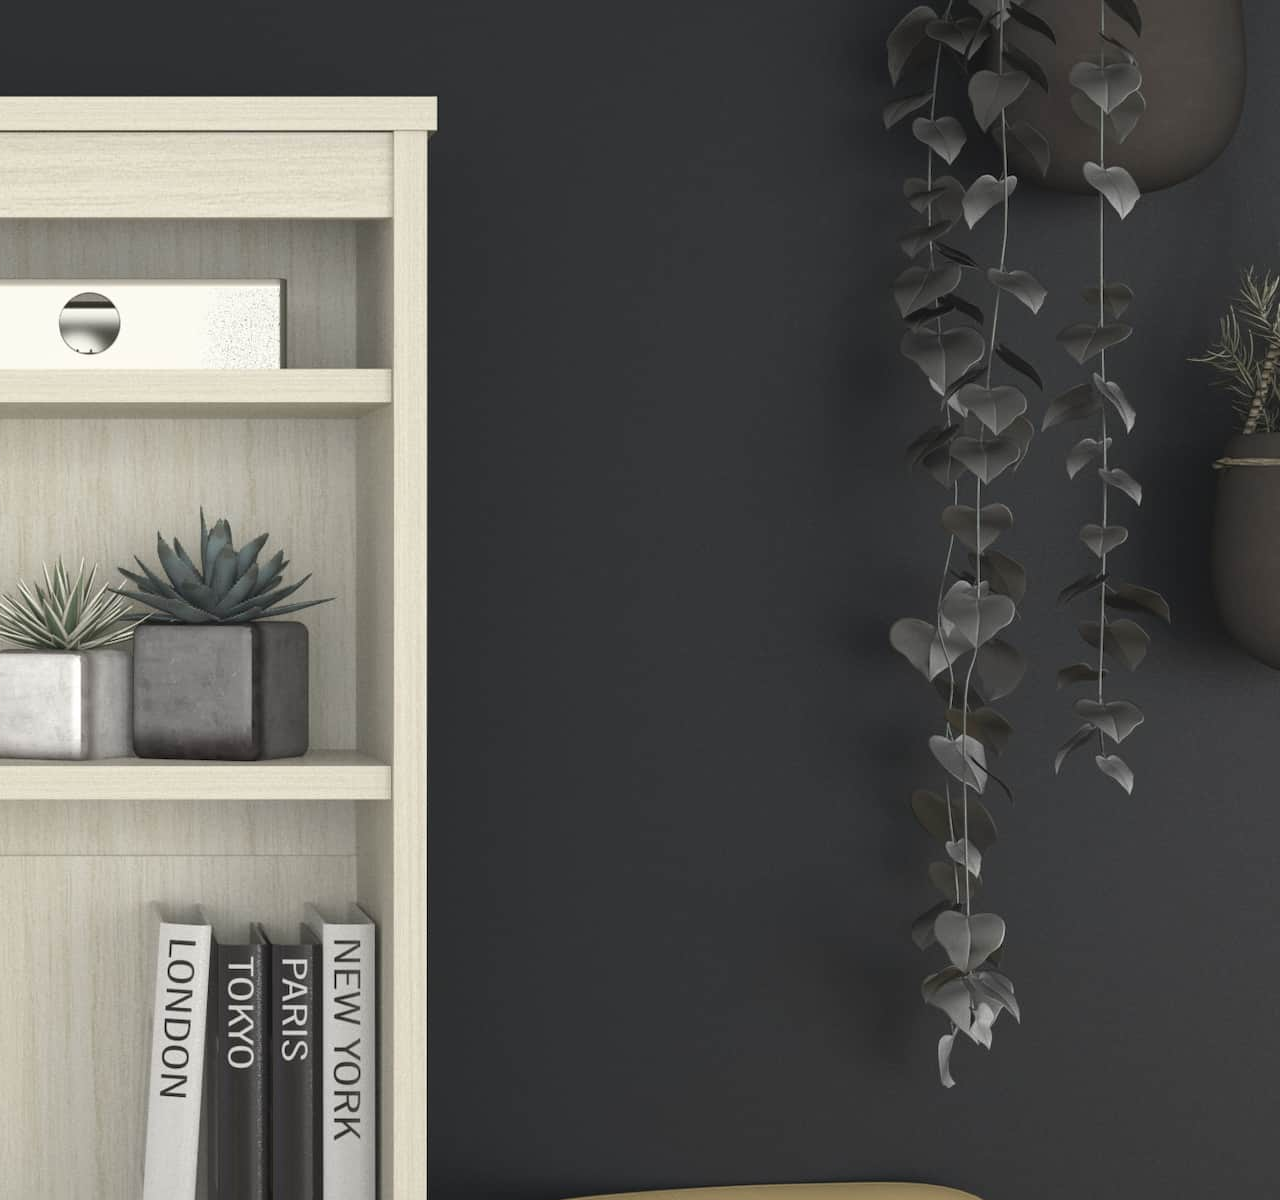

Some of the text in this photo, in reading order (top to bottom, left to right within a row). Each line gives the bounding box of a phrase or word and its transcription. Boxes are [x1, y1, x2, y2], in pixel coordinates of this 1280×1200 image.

[159, 938, 196, 1098] LONDON
[227, 956, 254, 1069] TOKYO
[281, 958, 308, 1061] PARIS
[333, 939, 361, 1141] NEW YORK
